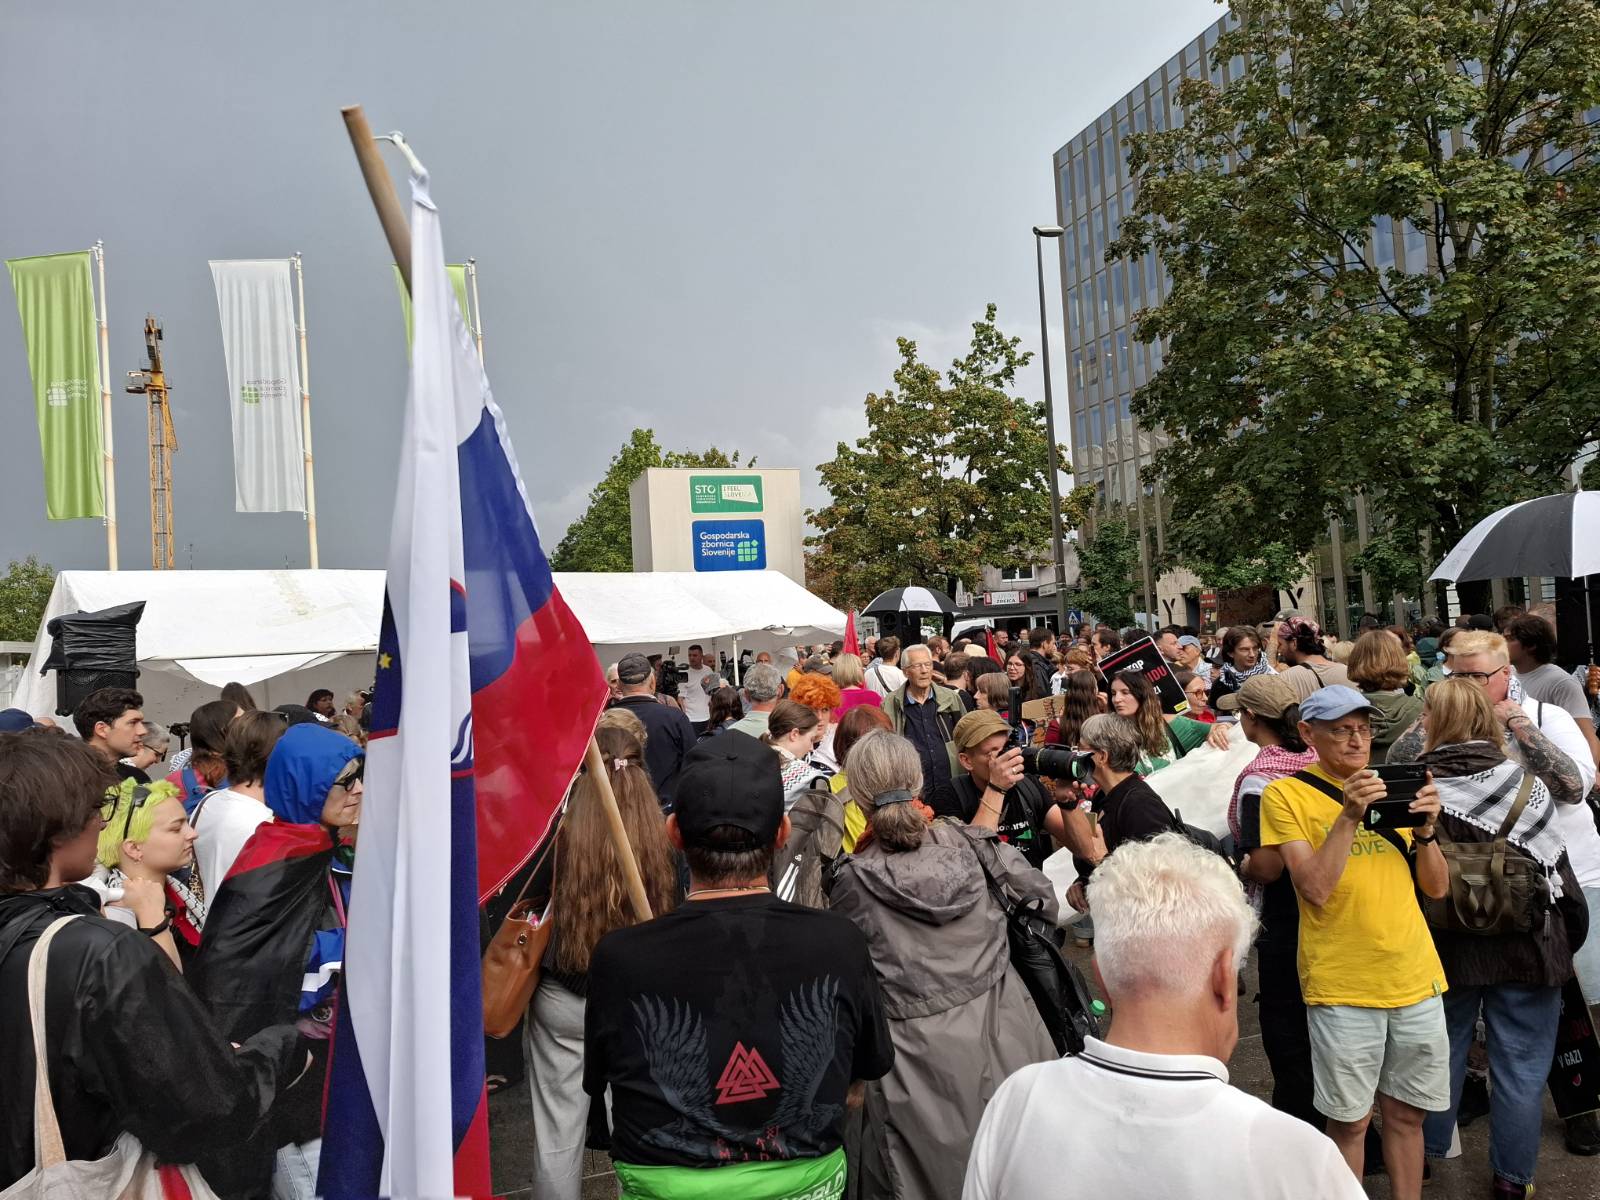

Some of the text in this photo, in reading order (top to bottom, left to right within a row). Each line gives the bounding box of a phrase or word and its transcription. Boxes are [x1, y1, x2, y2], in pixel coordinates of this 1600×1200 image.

[694, 484, 716, 494] STO
[700, 531, 750, 541] Gospodarska
[701, 540, 735, 548] zbornica
[701, 548, 736, 558] Slovenije
[1122, 659, 1144, 671] TOP
[1348, 840, 1385, 856] OVE
[1564, 1048, 1583, 1067] GAZI
